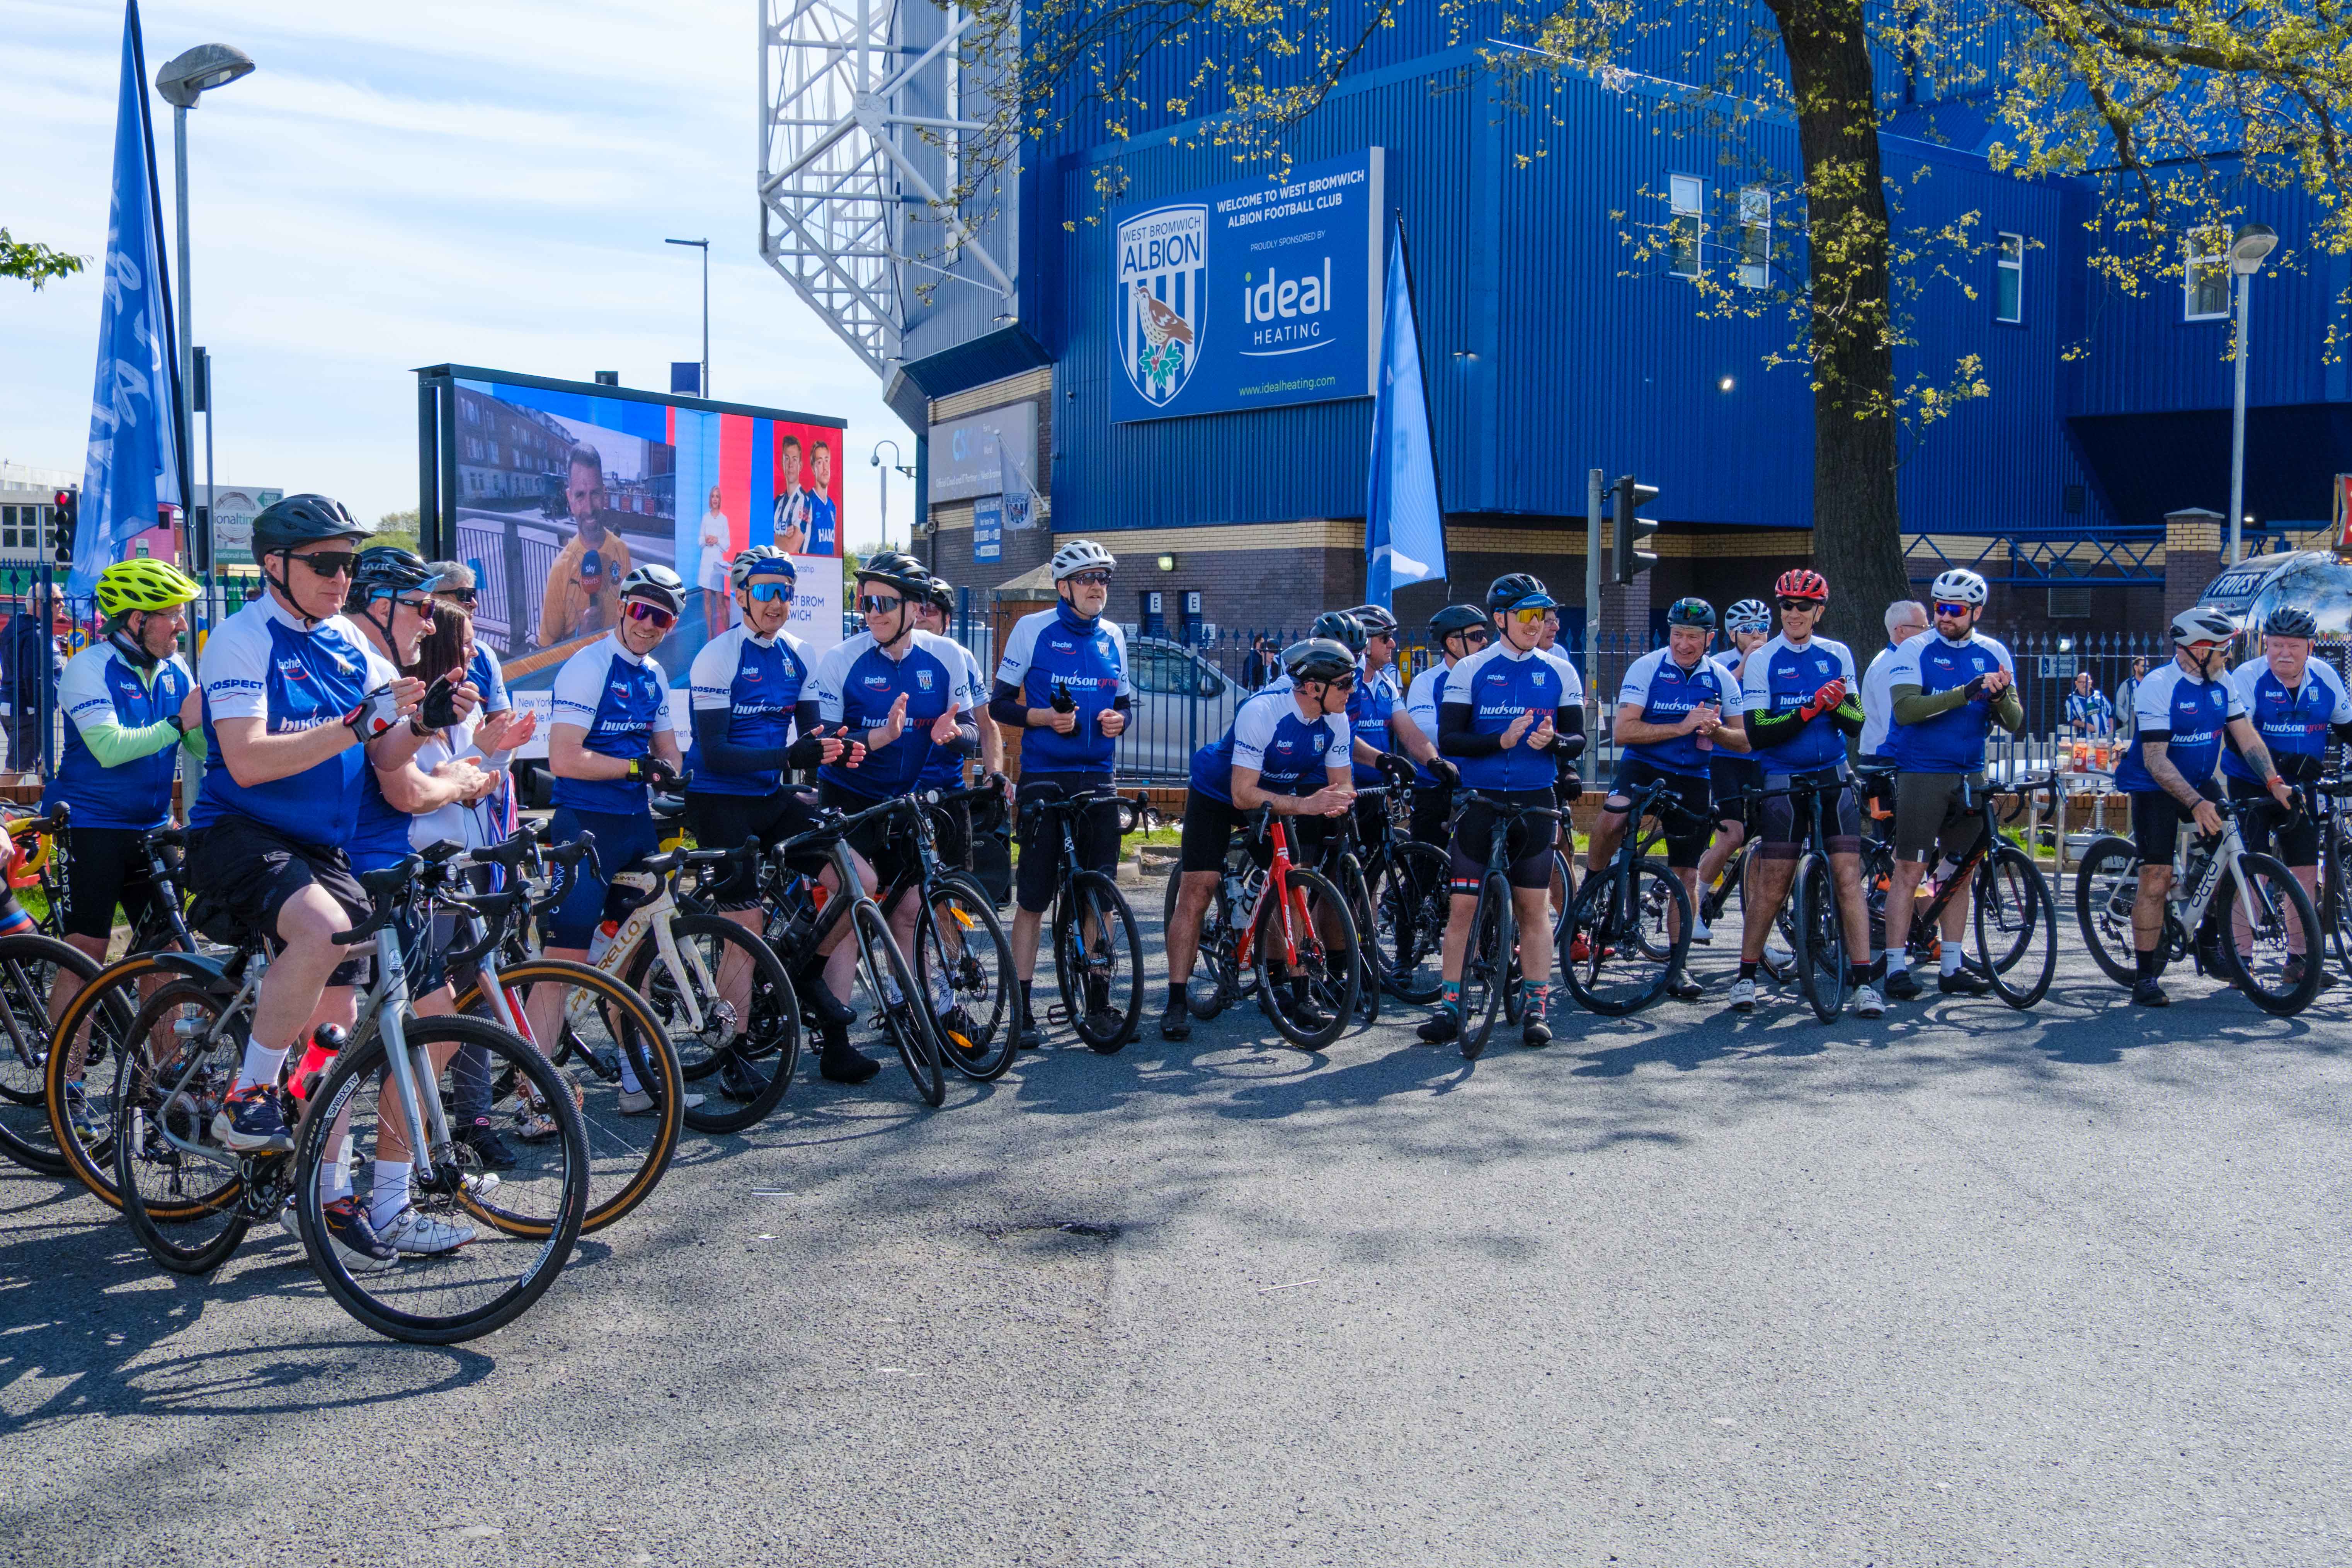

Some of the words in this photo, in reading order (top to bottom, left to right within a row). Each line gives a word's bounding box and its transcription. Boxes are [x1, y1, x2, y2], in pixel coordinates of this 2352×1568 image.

[1217, 193, 1261, 213] WELCOME
[1264, 191, 1276, 202] TO
[1280, 184, 1305, 199] WEST
[1310, 170, 1364, 192] BROMWICH
[1228, 210, 1262, 228] ALBION
[1264, 199, 1314, 222] FOOTBALL
[1317, 193, 1342, 209] CLUB
[1123, 226, 1147, 243] WEST
[1150, 216, 1201, 237] BROMWICH
[1251, 240, 1277, 252] PROUDLY
[1279, 233, 1316, 247] SPONSORED
[1317, 230, 1326, 240] BY
[1123, 232, 1200, 275] ALBION
[1245, 257, 1331, 323] ideal
[1254, 322, 1320, 345] HEATING
[1239, 376, 1335, 396] www.idealheating.com
[585, 564, 596, 574] sky
[796, 564, 814, 574] onship
[2212, 574, 2260, 596] FRIES
[801, 596, 824, 607] BROM
[1153, 598, 1158, 608] E
[1192, 597, 1197, 608] E
[1003, 656, 1021, 668] PECT
[70, 698, 113, 715] PROSPEC
[518, 698, 535, 707] New
[330, 1018, 364, 1077] PINNACLE
[119, 1053, 134, 1097] ALEXRIMS
[328, 1075, 359, 1118] ALEXRIMS
[306, 1118, 320, 1156] KENDA
[522, 1241, 553, 1284] ALEXRIMS
